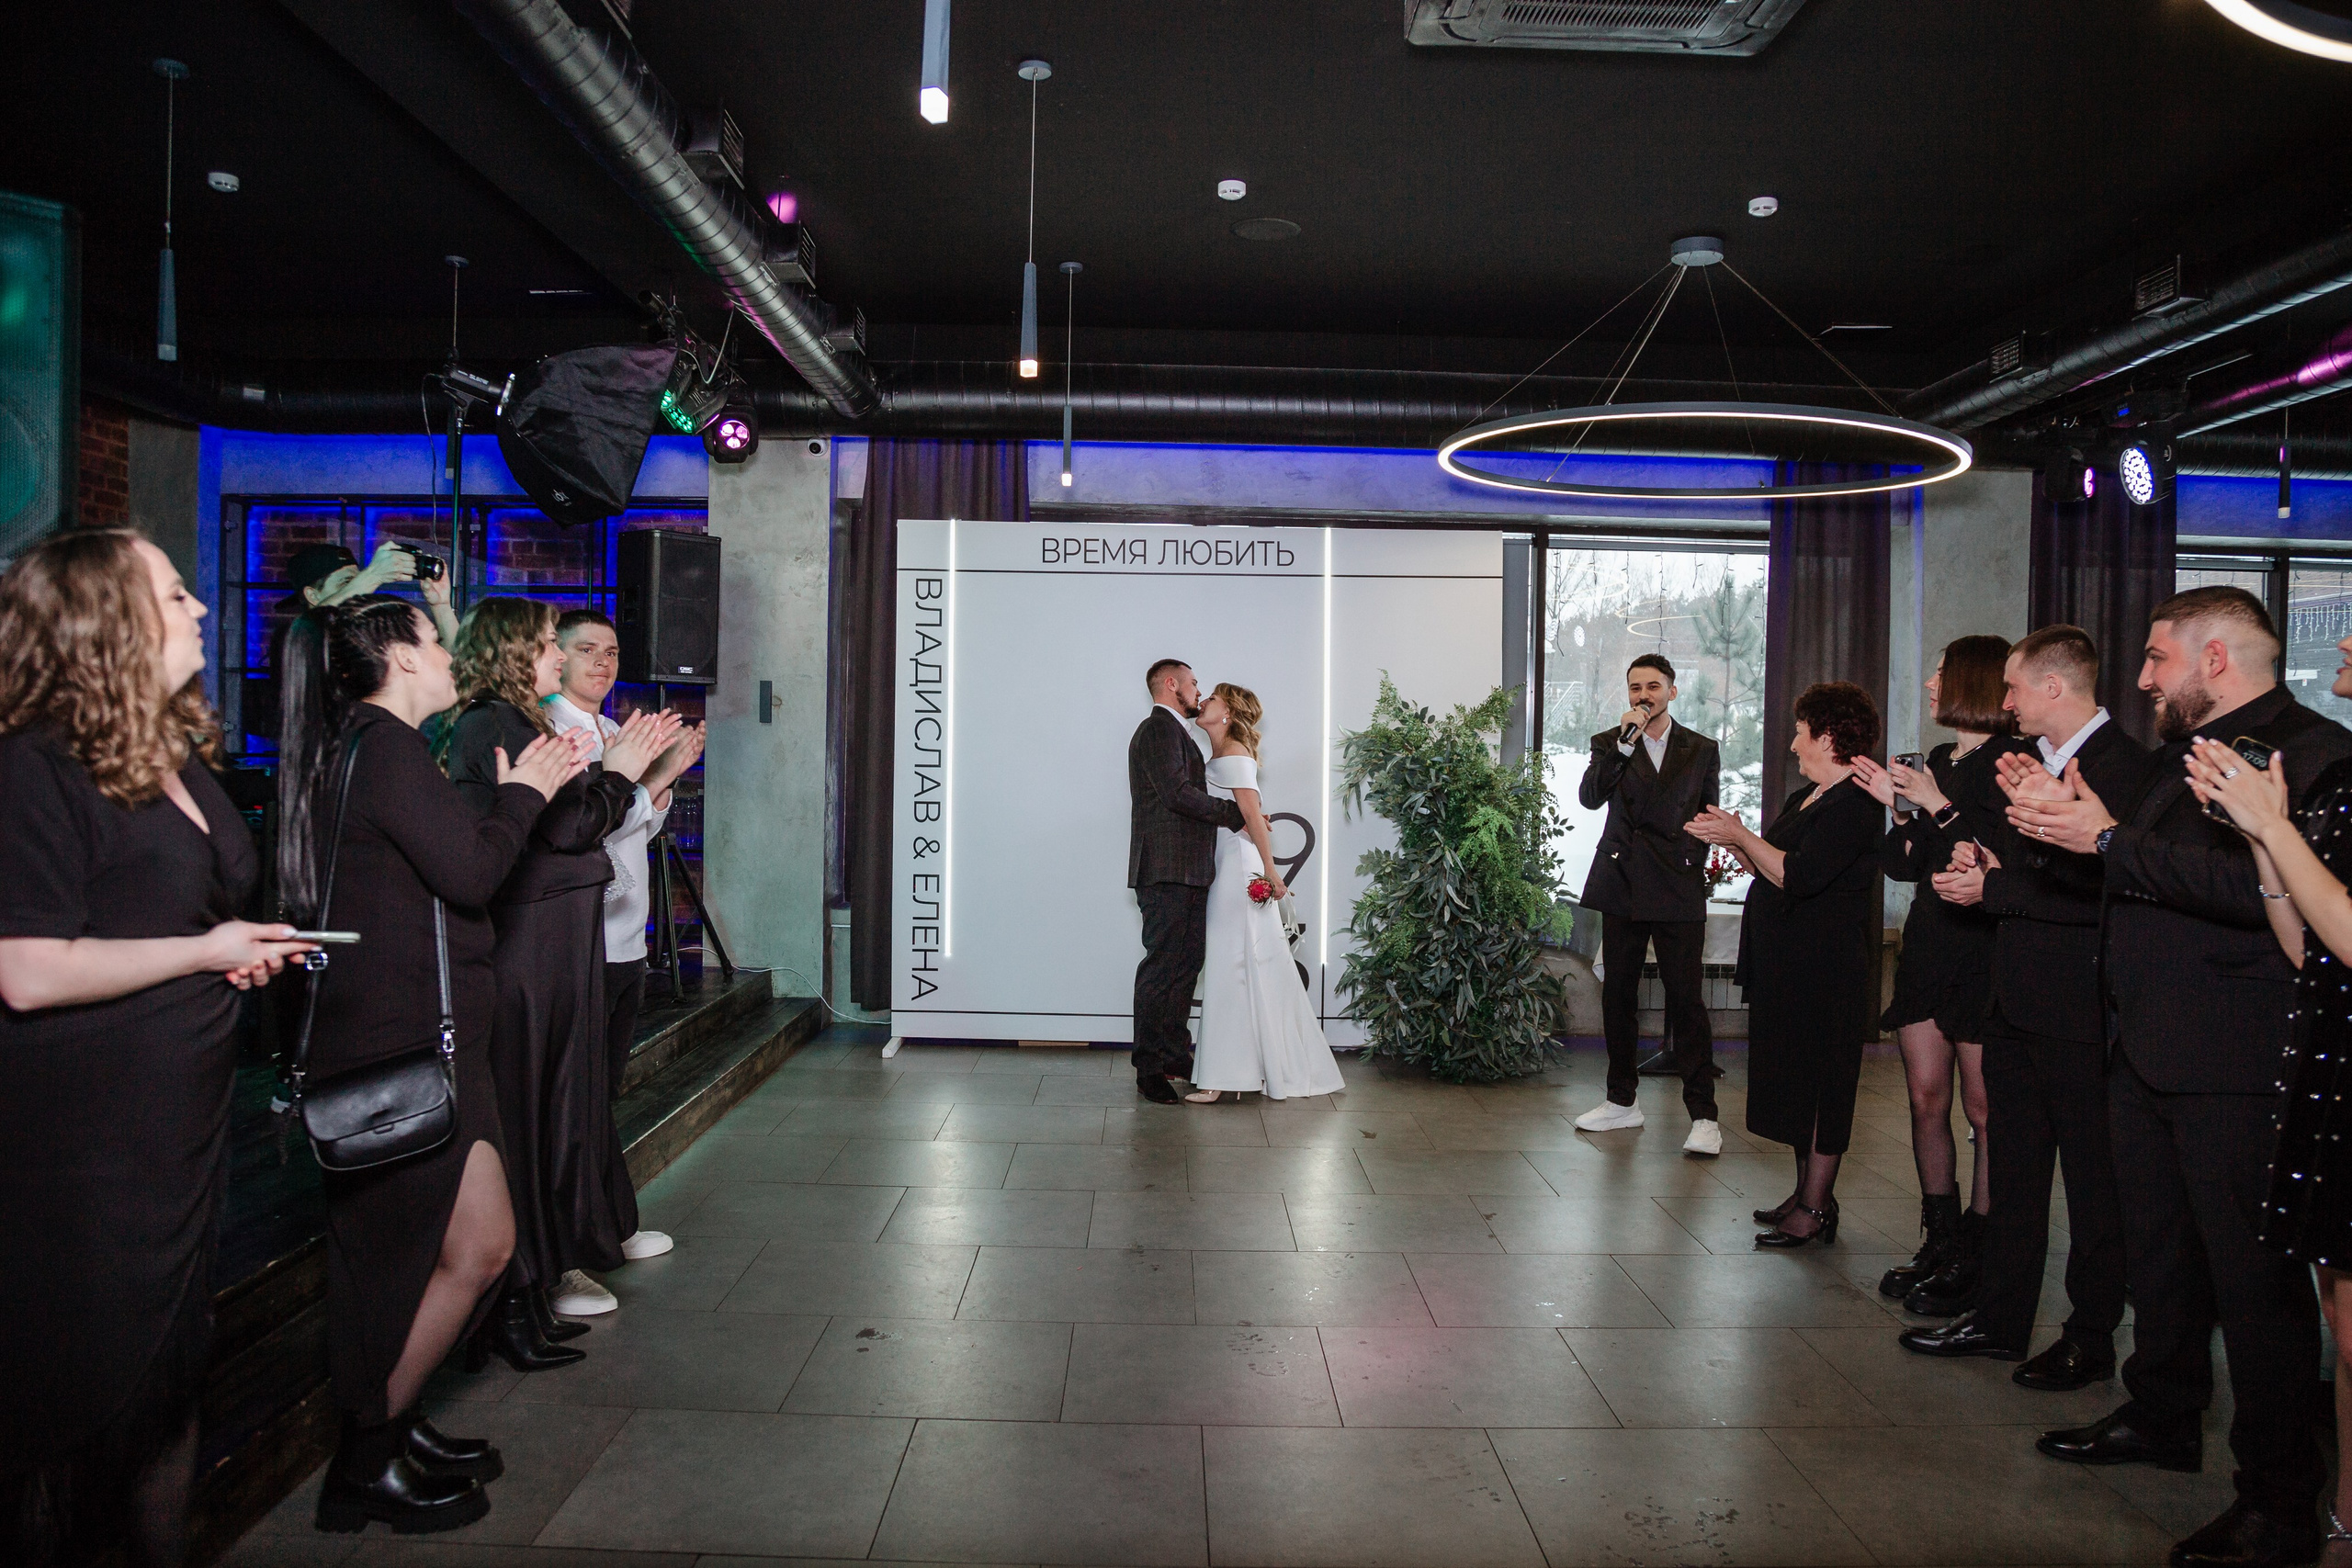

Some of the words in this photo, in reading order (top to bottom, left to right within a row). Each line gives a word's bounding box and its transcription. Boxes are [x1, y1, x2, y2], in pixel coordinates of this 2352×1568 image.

[1042, 537, 1147, 565] ВРЕМЯ
[1158, 539, 1295, 567] ЛЮБИТЬ
[910, 578, 943, 823] ВЛАДИСЛАВ
[913, 836, 941, 860] &
[910, 874, 941, 1001] ЕЛЕНА
